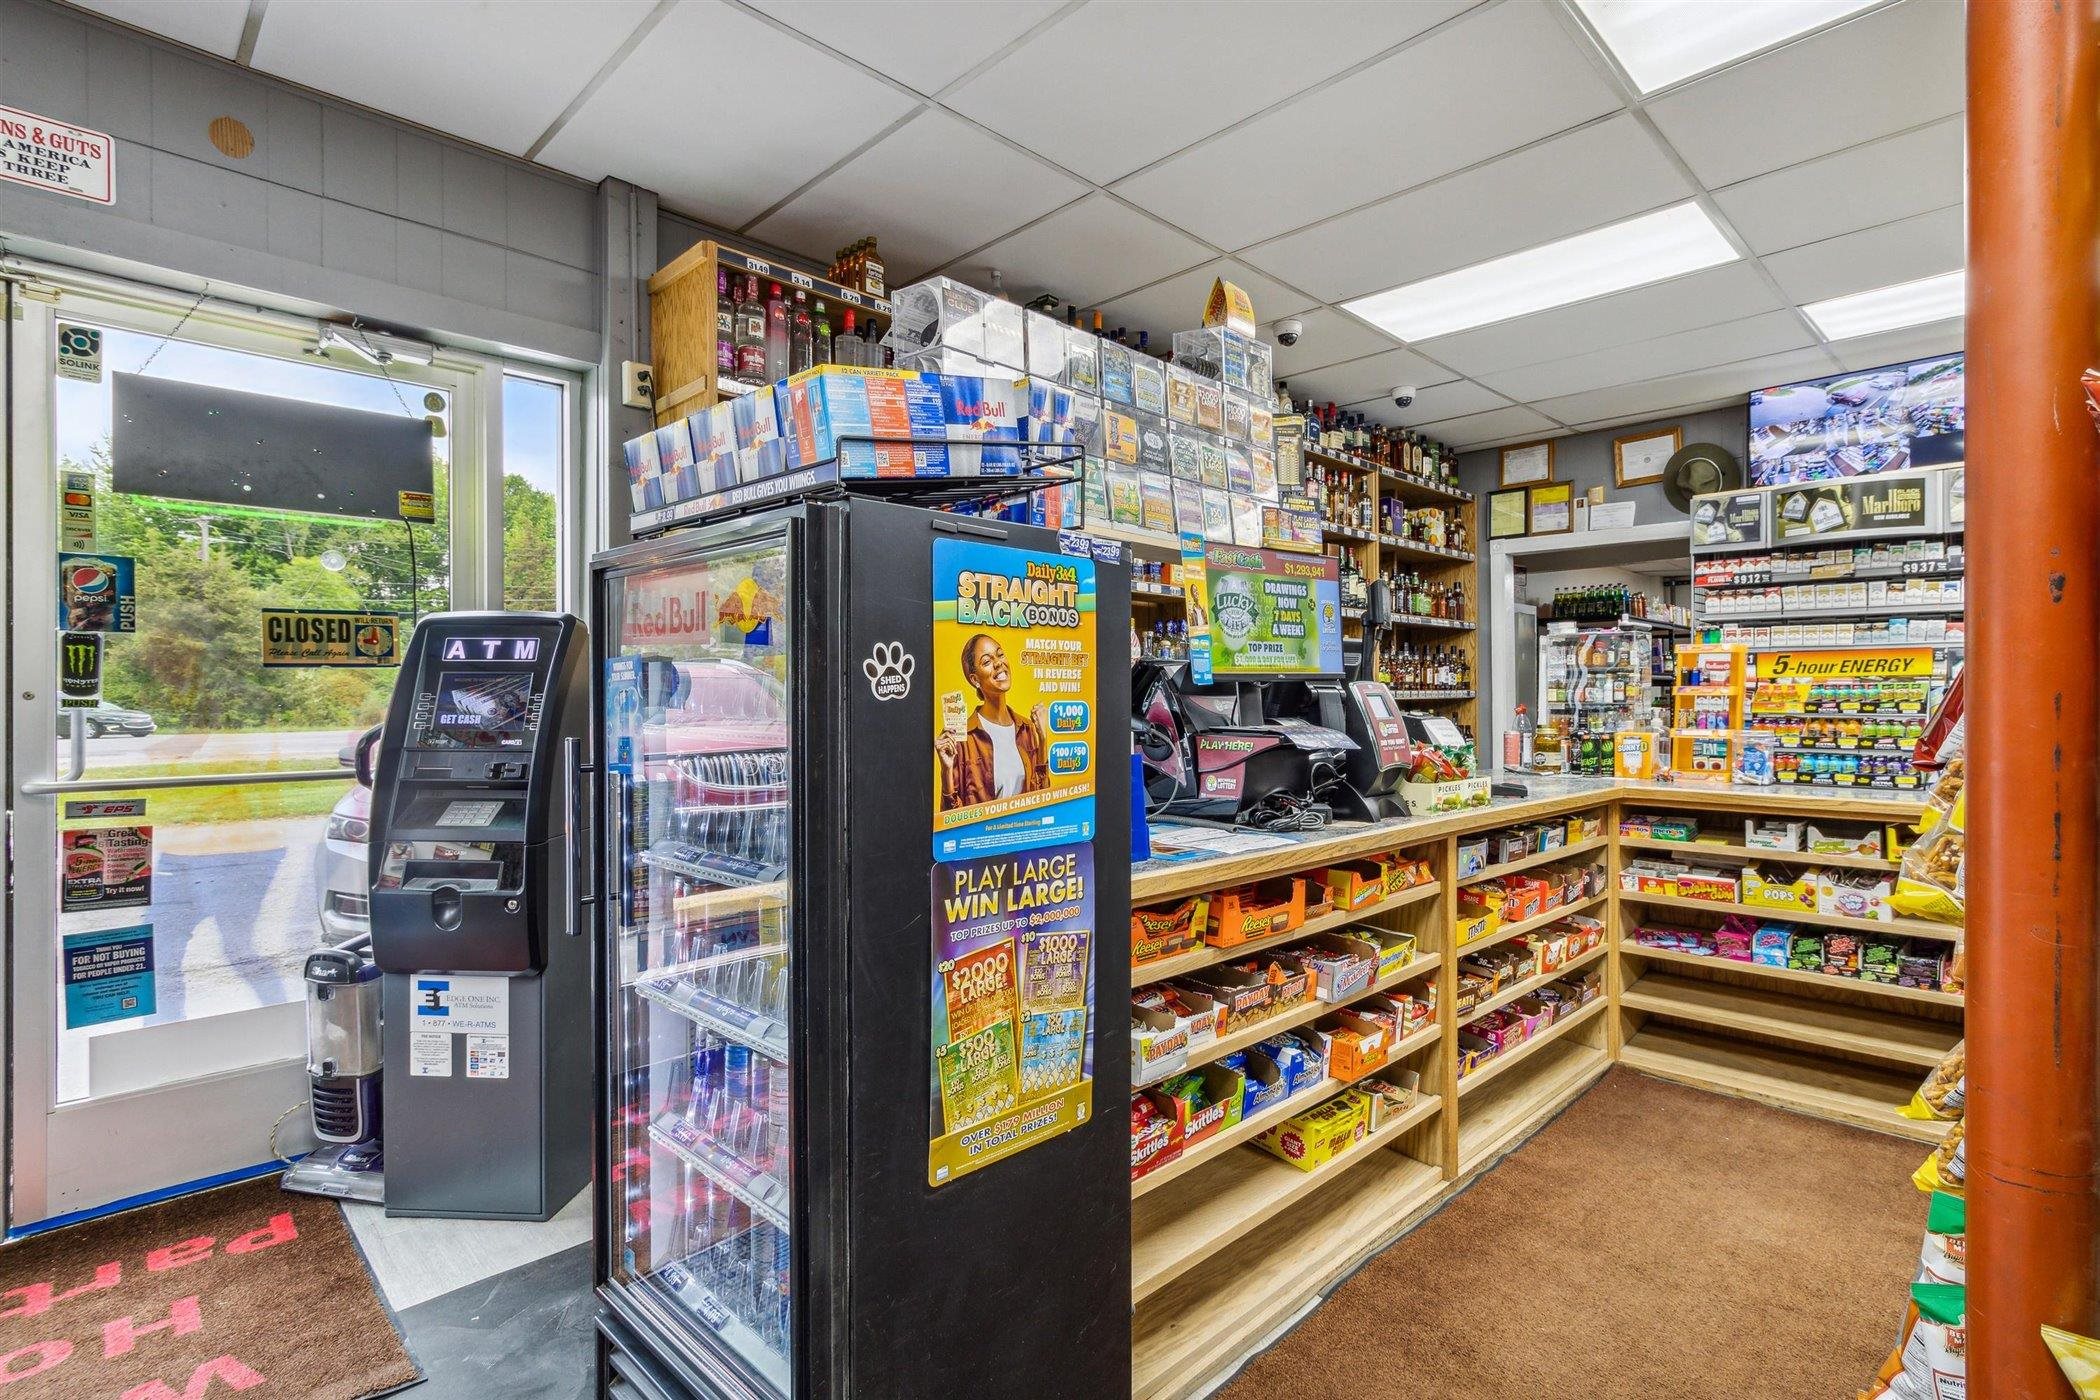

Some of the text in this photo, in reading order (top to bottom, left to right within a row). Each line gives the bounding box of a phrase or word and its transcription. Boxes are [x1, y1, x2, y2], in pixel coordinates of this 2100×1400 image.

[32, 127, 45, 146] &
[49, 132, 102, 160] GUTS
[4, 139, 92, 170] AMERICA
[18, 152, 71, 174] KEEP
[3, 160, 69, 185] THREE
[60, 357, 101, 371] SOLINK
[850, 368, 862, 376] CAN
[863, 369, 885, 378] VARIETY
[885, 370, 900, 378] PACK
[955, 398, 1006, 418] Red Bull
[731, 491, 742, 504] RED
[743, 486, 758, 502] BULL
[757, 482, 774, 498] GIVES
[774, 479, 788, 493] YOU
[1863, 488, 1921, 515] Marlboro
[69, 510, 90, 519] VISA
[1729, 507, 1760, 524] Marlboro
[1027, 561, 1056, 583] Daily
[958, 571, 1078, 607] STRAIGHT
[1264, 581, 1308, 596] DRAWINGS
[74, 594, 107, 605] pepsi
[1217, 594, 1253, 611] Lucky
[1277, 598, 1298, 609] NOW
[120, 595, 135, 631] PUSH
[669, 590, 707, 635] Bull
[958, 597, 1079, 628] BACK BONUS
[1274, 611, 1301, 622] 7 DAYS
[370, 617, 394, 625] RETURN
[268, 616, 352, 644] CLOSED
[1272, 625, 1304, 636] A WEEK!
[1026, 638, 1082, 651] MATCH YOUR
[1248, 643, 1284, 653] TOP PRIZE
[268, 648, 351, 659] Please Call Again
[1020, 650, 1089, 667] STRAIGHT BET
[1773, 654, 1915, 675] 5-hour ENERGY
[880, 675, 902, 686] SHED
[1033, 668, 1082, 680] IN REVERSE
[877, 683, 905, 695] HAPPENS
[1039, 681, 1081, 693] AND WIN!
[64, 698, 98, 708] PUSH
[1053, 703, 1084, 718] $1,000
[440, 714, 482, 726] GET CASH
[1056, 718, 1076, 731] Daily
[1052, 746, 1069, 757] $100
[1074, 746, 1086, 756] $50
[1200, 740, 1254, 753] PLAY HERE!
[1057, 757, 1076, 769] Daily
[1438, 785, 1461, 793] PICKLES
[1467, 780, 1488, 790] PICKLES
[103, 804, 135, 814] EPS
[944, 782, 1090, 825] DOUBLES YOUR CHANCE TO WIN CASH!
[108, 829, 138, 838] Great
[1619, 825, 1649, 833] mentos
[955, 853, 1076, 895] PLAY LARGE
[105, 886, 119, 895] Try
[126, 884, 145, 893] now!
[1763, 888, 1794, 901] POPS
[944, 876, 1085, 924] WIN LARGE!
[951, 906, 1081, 943] TOP PRIZES UP TO $2,000,000
[1021, 931, 1036, 943] $10
[1039, 935, 1078, 951] $1000
[72, 946, 146, 967] FOR NOT BUYING
[73, 963, 97, 972] TOBACCO
[120, 956, 146, 965] PRODUCTS
[1041, 949, 1073, 965] LARGE
[73, 962, 146, 980] FOR PEOPLE UNDER 21.
[311, 966, 338, 978] Shark
[938, 959, 956, 973] $20
[952, 952, 1009, 991] $2000
[960, 974, 1004, 1004] LARGE
[1235, 985, 1270, 1011] PAYDAY
[433, 1020, 446, 1028] 877
[452, 1020, 497, 1029] WE-R-ATMS
[1148, 1030, 1188, 1062] PAYDAY
[960, 1127, 991, 1147] OVER
[993, 1115, 1021, 1136] $179
[1022, 1098, 1065, 1122] MILLION
[1184, 1105, 1225, 1140] Skittles
[968, 1113, 1058, 1156] IN TOTAL PRIZES!
[1131, 1133, 1169, 1166] Skittles
